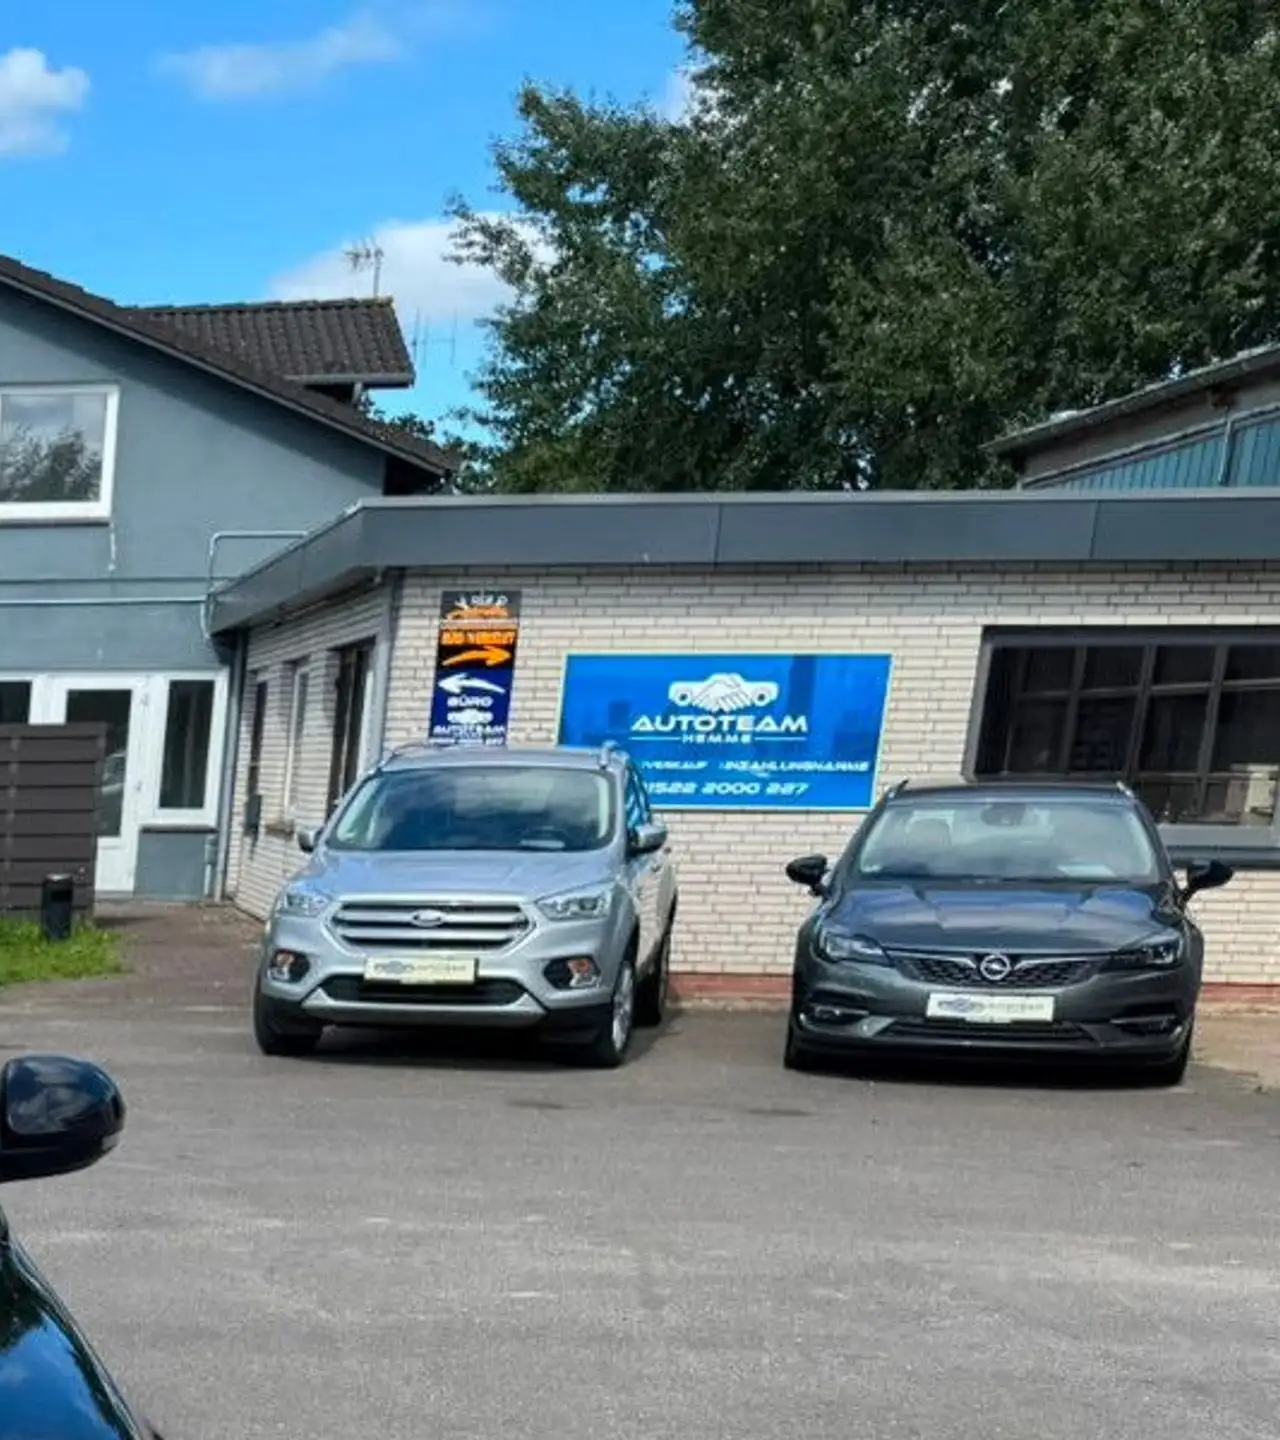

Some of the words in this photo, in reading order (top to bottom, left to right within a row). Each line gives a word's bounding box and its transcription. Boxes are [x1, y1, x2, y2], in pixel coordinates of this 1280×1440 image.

[630, 713, 808, 733] AUTOTEAM
[682, 733, 752, 744] HEMME
[701, 781, 761, 796] 2000
